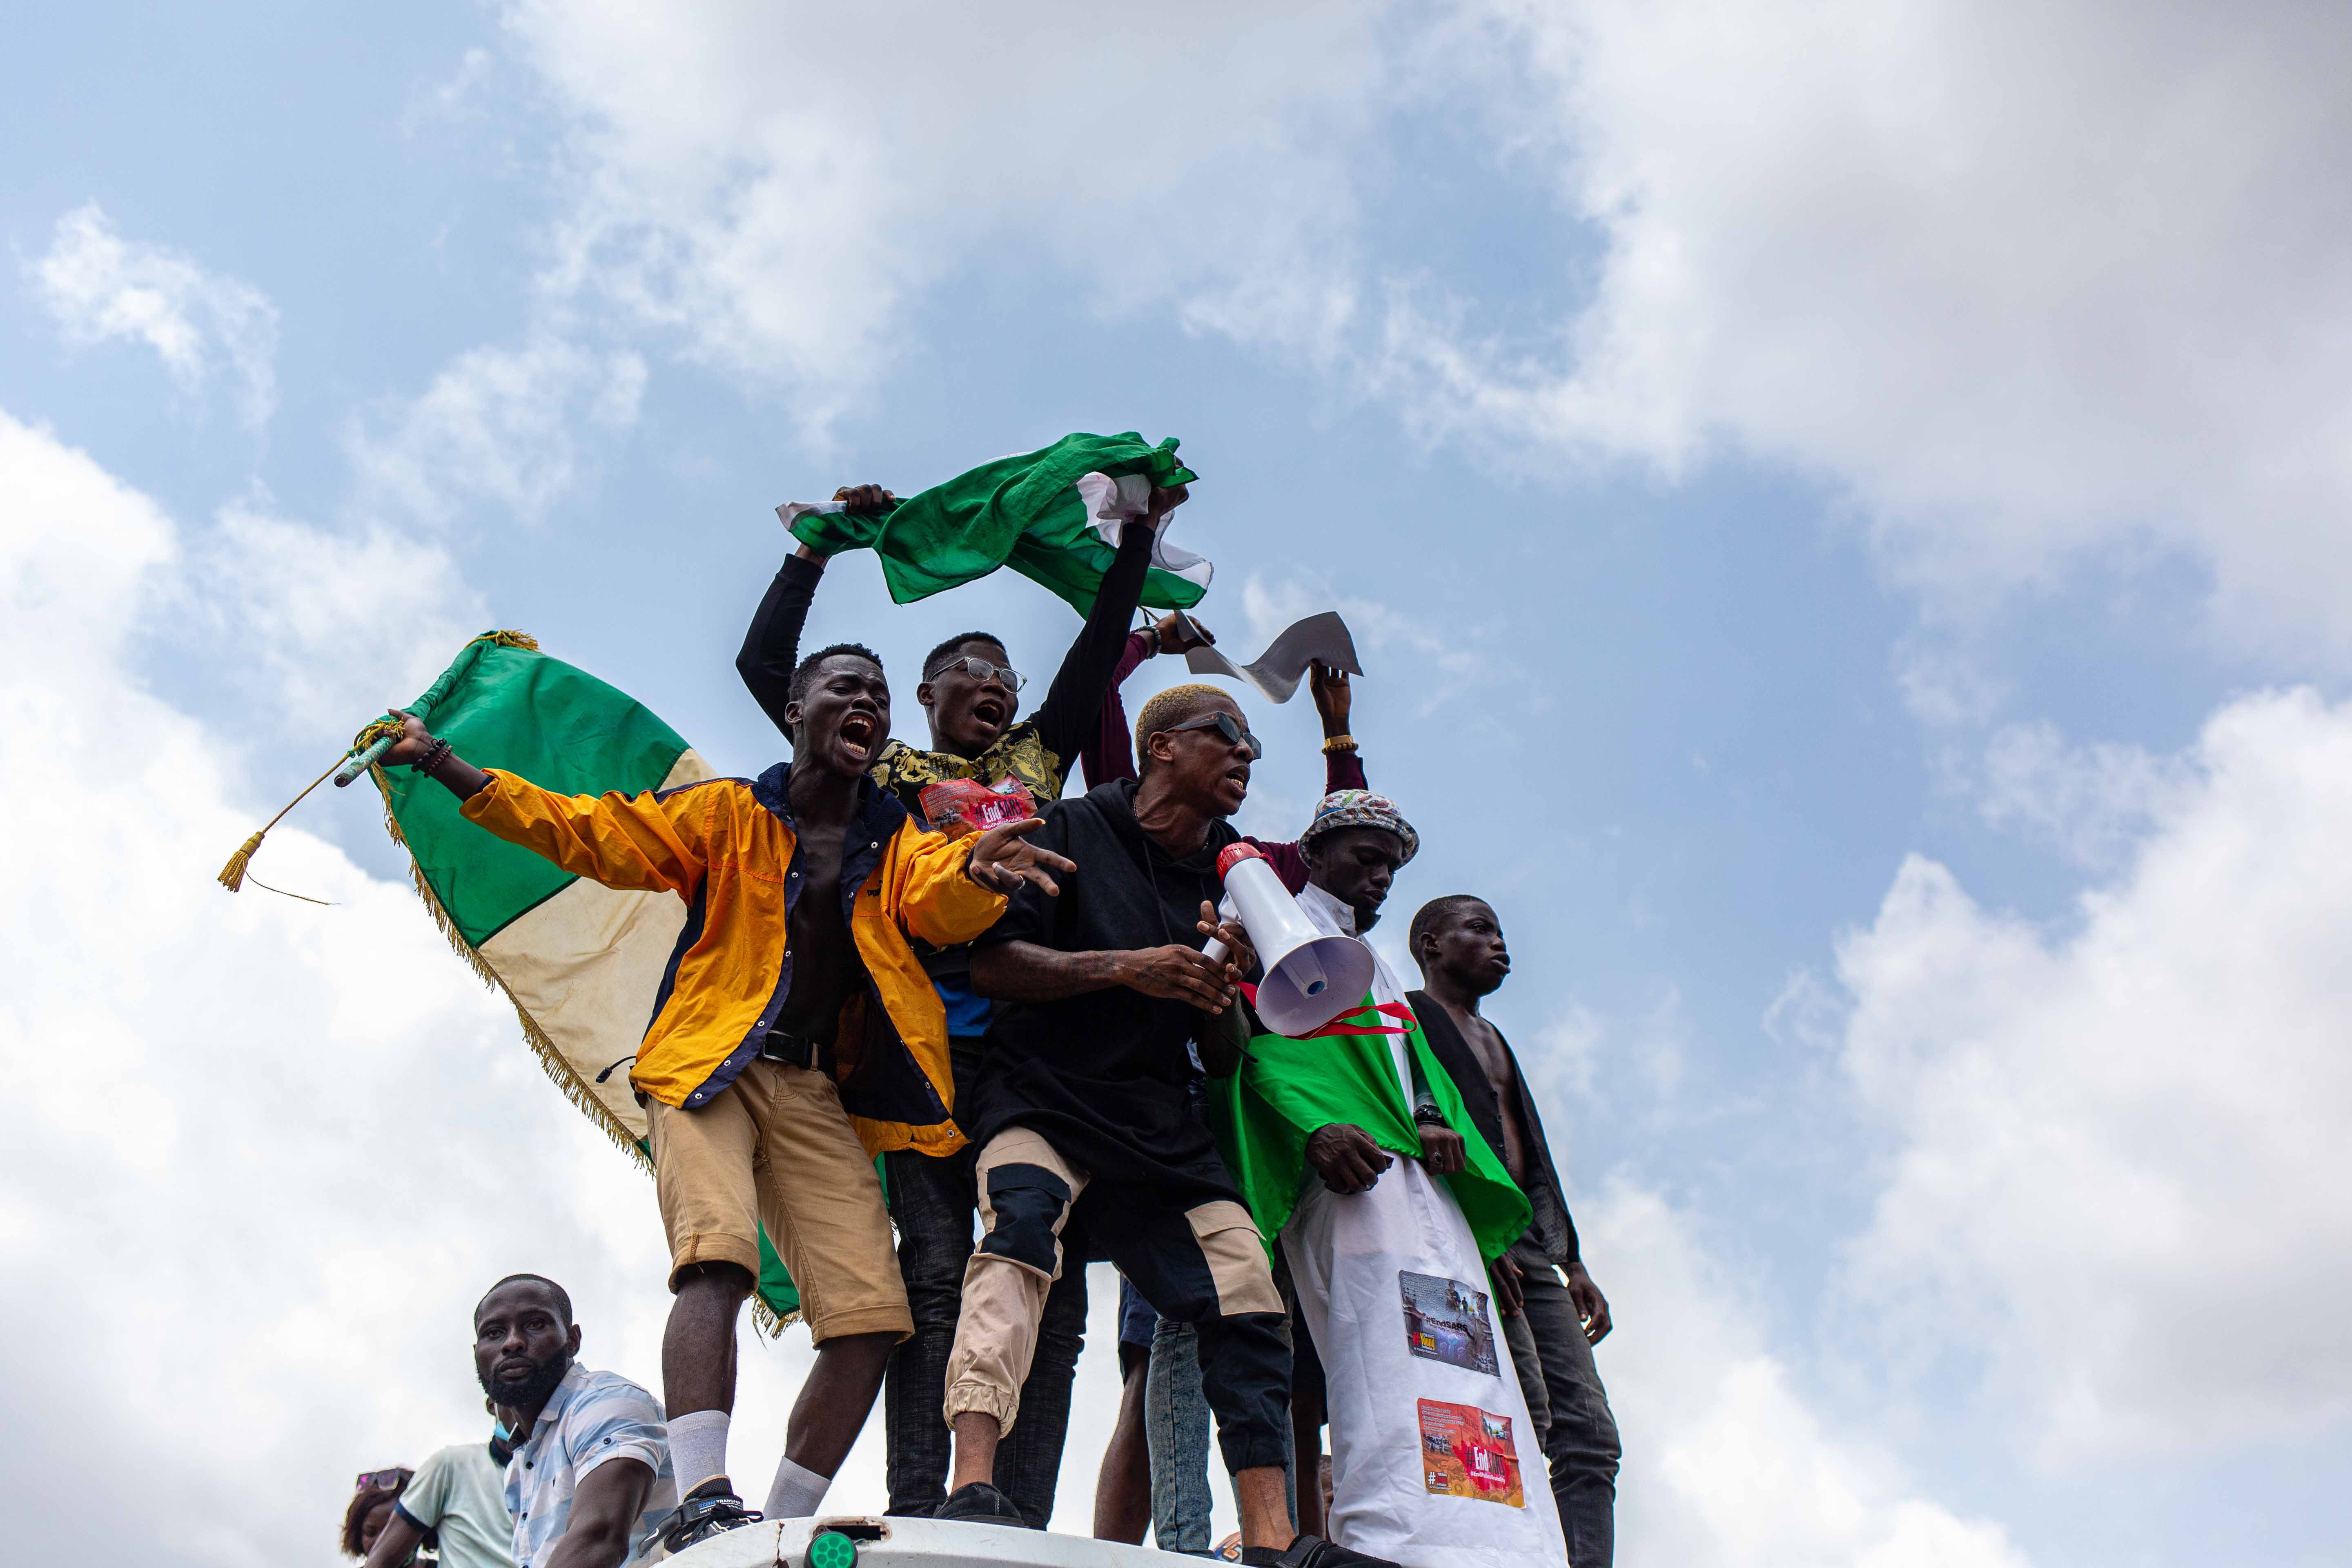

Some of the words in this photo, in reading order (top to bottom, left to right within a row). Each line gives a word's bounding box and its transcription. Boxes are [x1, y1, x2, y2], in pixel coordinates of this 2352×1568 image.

[973, 798, 1022, 824] #EndSARS
[983, 816, 1023, 829] #EndPoliceBrutality
[1425, 1316, 1468, 1332] #EndSARS
[1420, 1332, 1435, 1351] Young
[1464, 1447, 1505, 1476] #EndSARS
